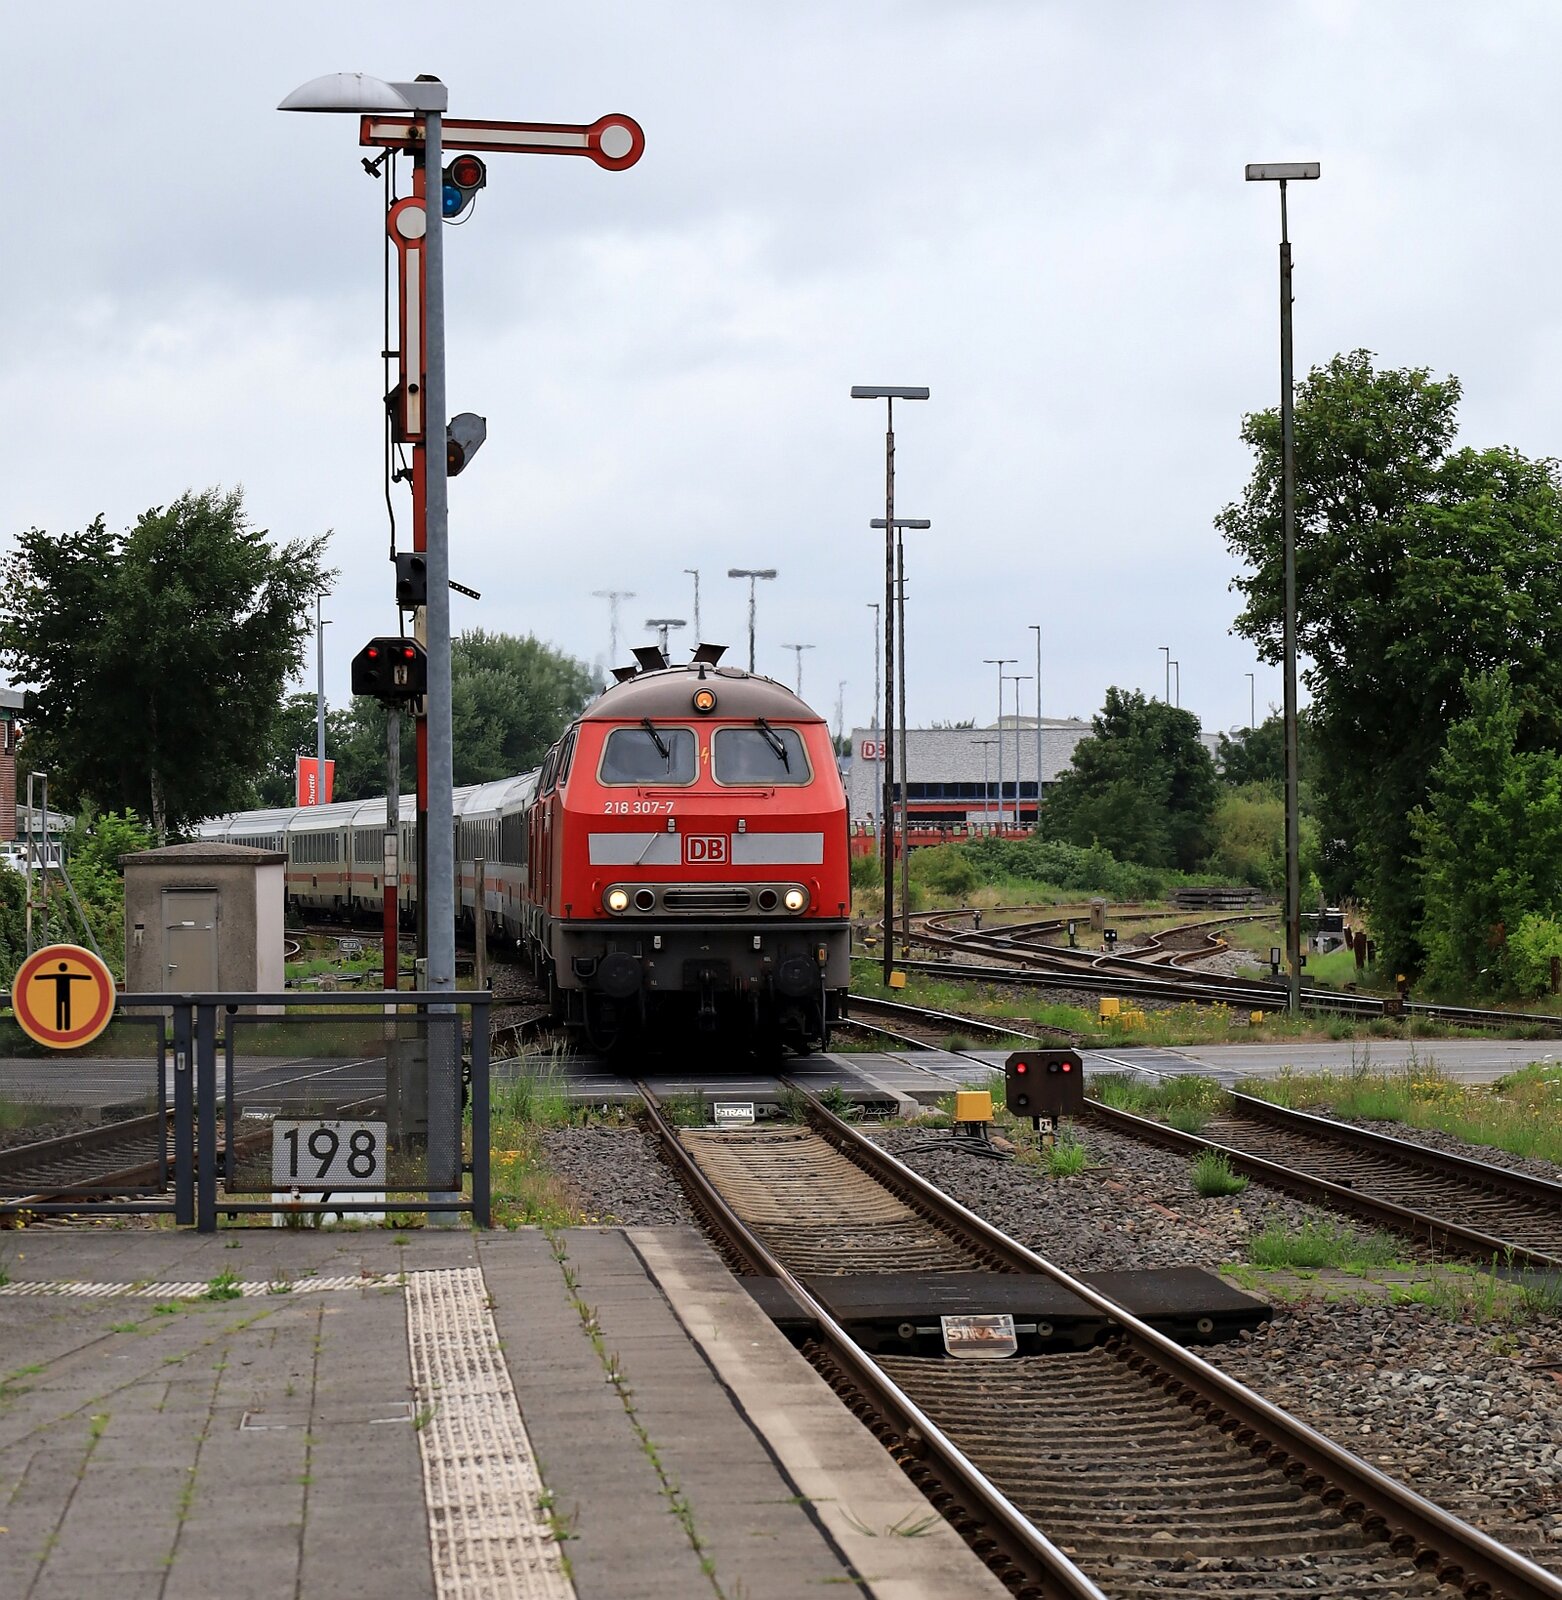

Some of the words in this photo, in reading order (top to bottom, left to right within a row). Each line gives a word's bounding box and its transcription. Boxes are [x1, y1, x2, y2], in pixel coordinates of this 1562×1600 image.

[308, 773, 316, 805] Shuttle
[604, 802, 629, 814] 218
[633, 802, 674, 814] 307-7
[690, 839, 723, 860] DB
[716, 1107, 753, 1118] STRAIL
[284, 1128, 377, 1178] 198
